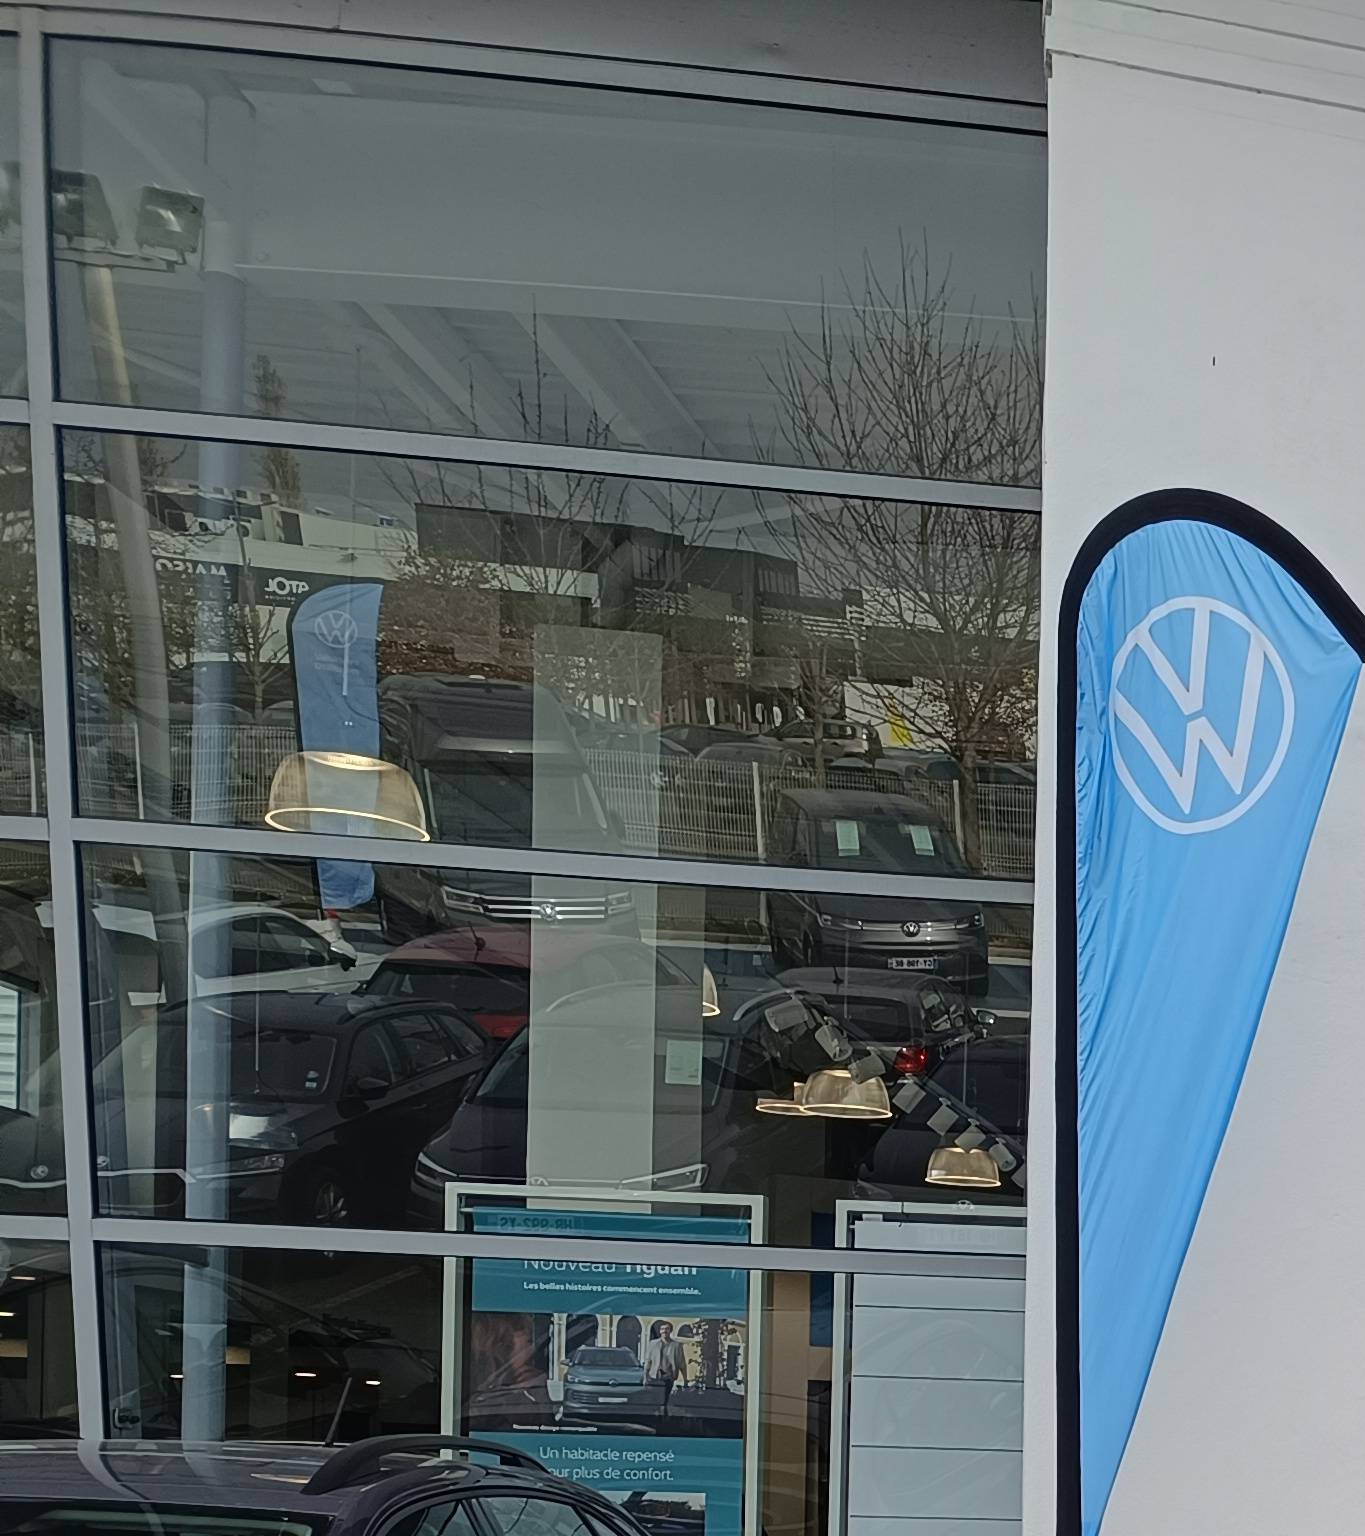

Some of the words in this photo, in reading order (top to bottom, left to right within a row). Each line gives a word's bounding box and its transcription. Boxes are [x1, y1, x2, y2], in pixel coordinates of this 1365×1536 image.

[538, 1281, 565, 1291] belles
[565, 1282, 602, 1292] histoires
[602, 1284, 657, 1295] commencent
[540, 1447, 561, 1460] Un
[562, 1447, 620, 1461] habitacle
[622, 1449, 675, 1464] repensé
[548, 1468, 570, 1479] our
[573, 1466, 601, 1481] plus
[603, 1466, 621, 1480] de
[623, 1467, 675, 1481] confort.
